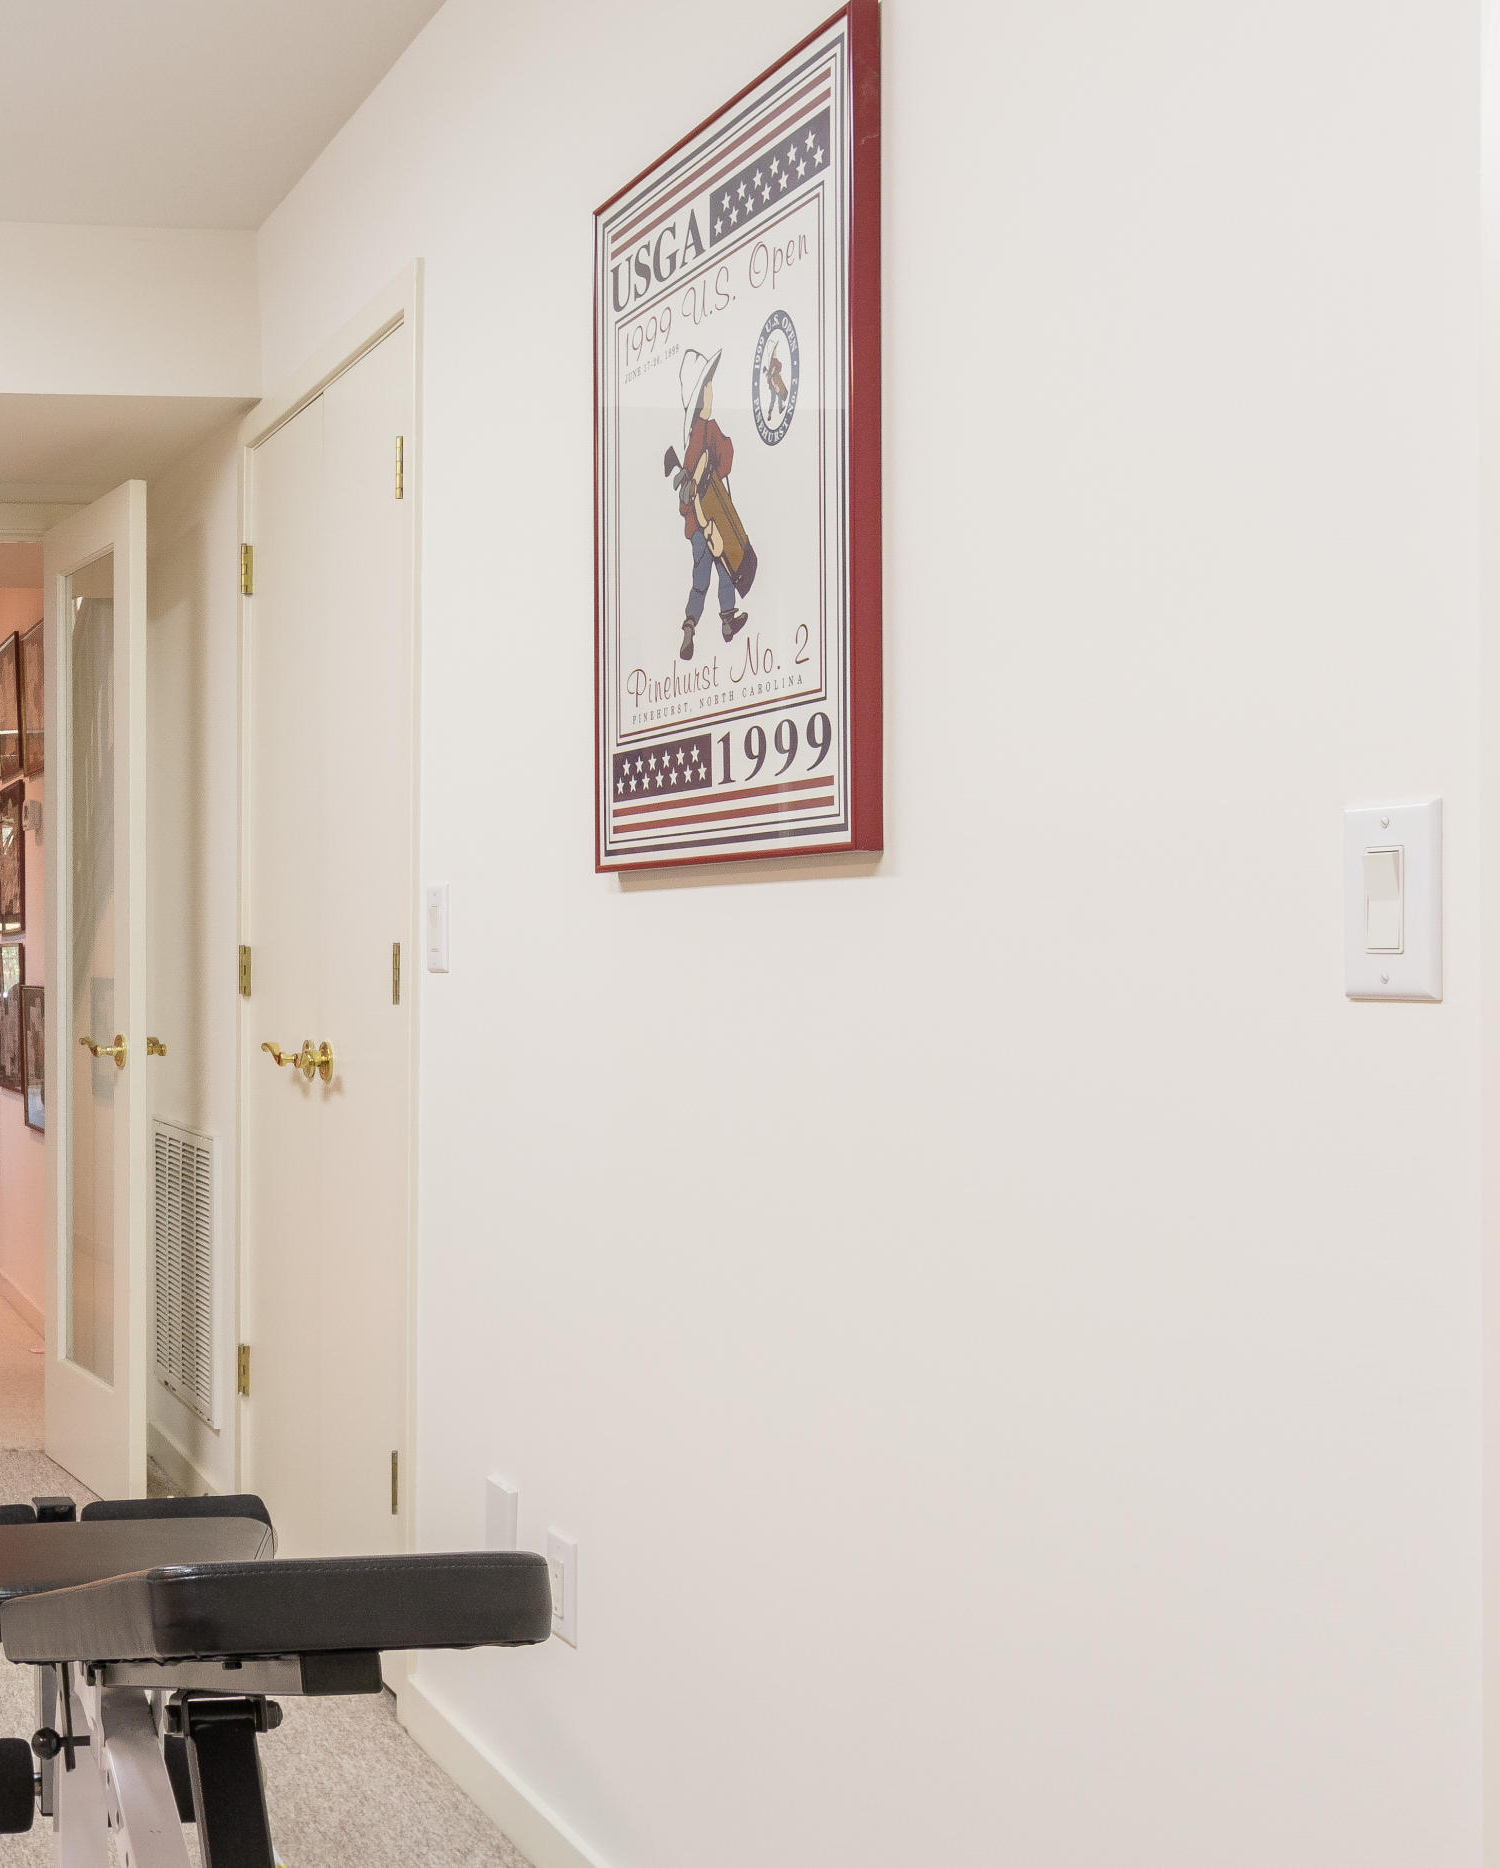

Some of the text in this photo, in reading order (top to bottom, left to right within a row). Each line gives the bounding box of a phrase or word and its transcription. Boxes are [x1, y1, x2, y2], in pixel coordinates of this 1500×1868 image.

[610, 208, 707, 313] USGA
[625, 232, 809, 367] 1999 U.S. Open
[781, 316, 798, 353] OPEN
[626, 623, 810, 708] Pinehurst No. 2
[699, 690, 735, 709] NORTH
[742, 673, 804, 698] CAROLINA
[716, 711, 833, 786] 1999
